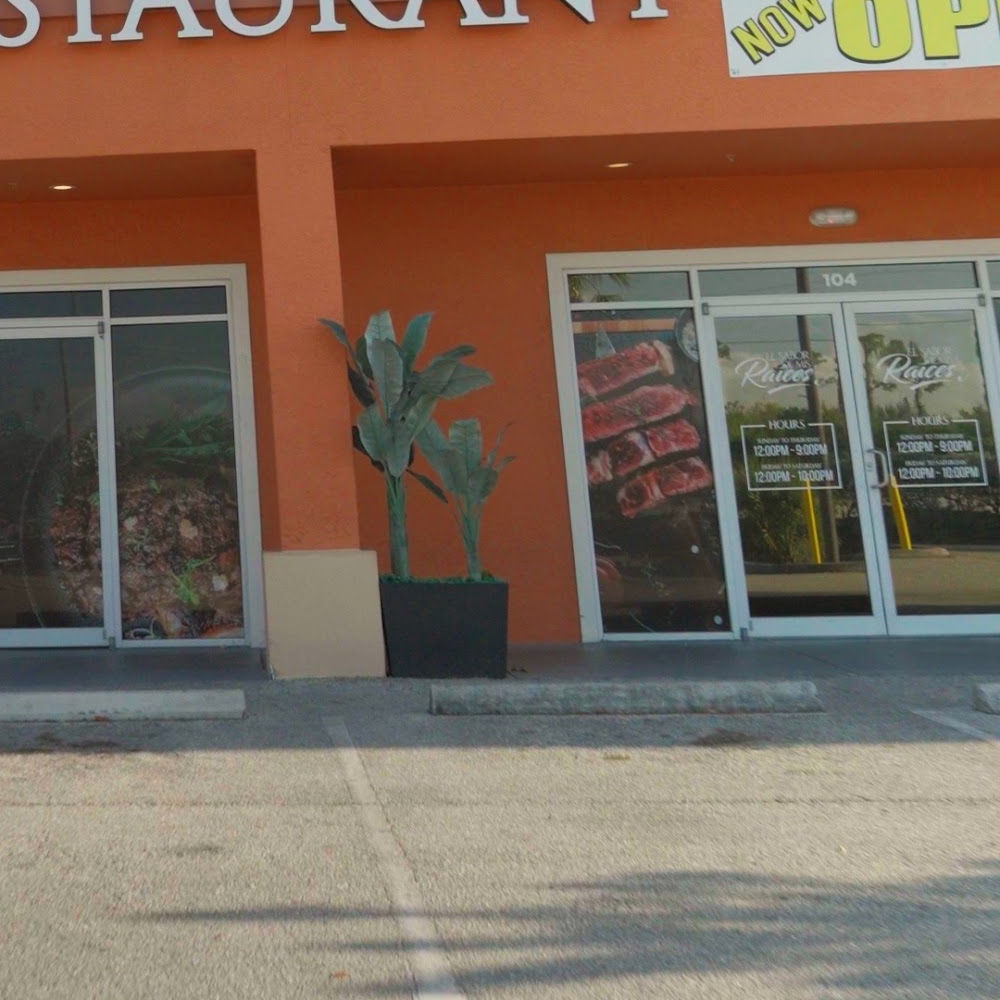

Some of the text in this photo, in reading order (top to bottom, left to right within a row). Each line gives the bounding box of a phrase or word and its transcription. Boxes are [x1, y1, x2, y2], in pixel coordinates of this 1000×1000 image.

[822, 272, 858, 287] 104
[768, 419, 806, 430] HOURS
[911, 415, 949, 426] HOURS
[753, 444, 790, 457] 12:00PM
[795, 443, 828, 456] 9:00PM
[897, 440, 934, 453] 12:00PM
[939, 440, 973, 452] 9:00PM
[754, 470, 791, 483] 12:00PM
[798, 469, 834, 482] 10:00PM
[898, 467, 935, 479] 12:00PM
[941, 466, 980, 478] 10:00PM
